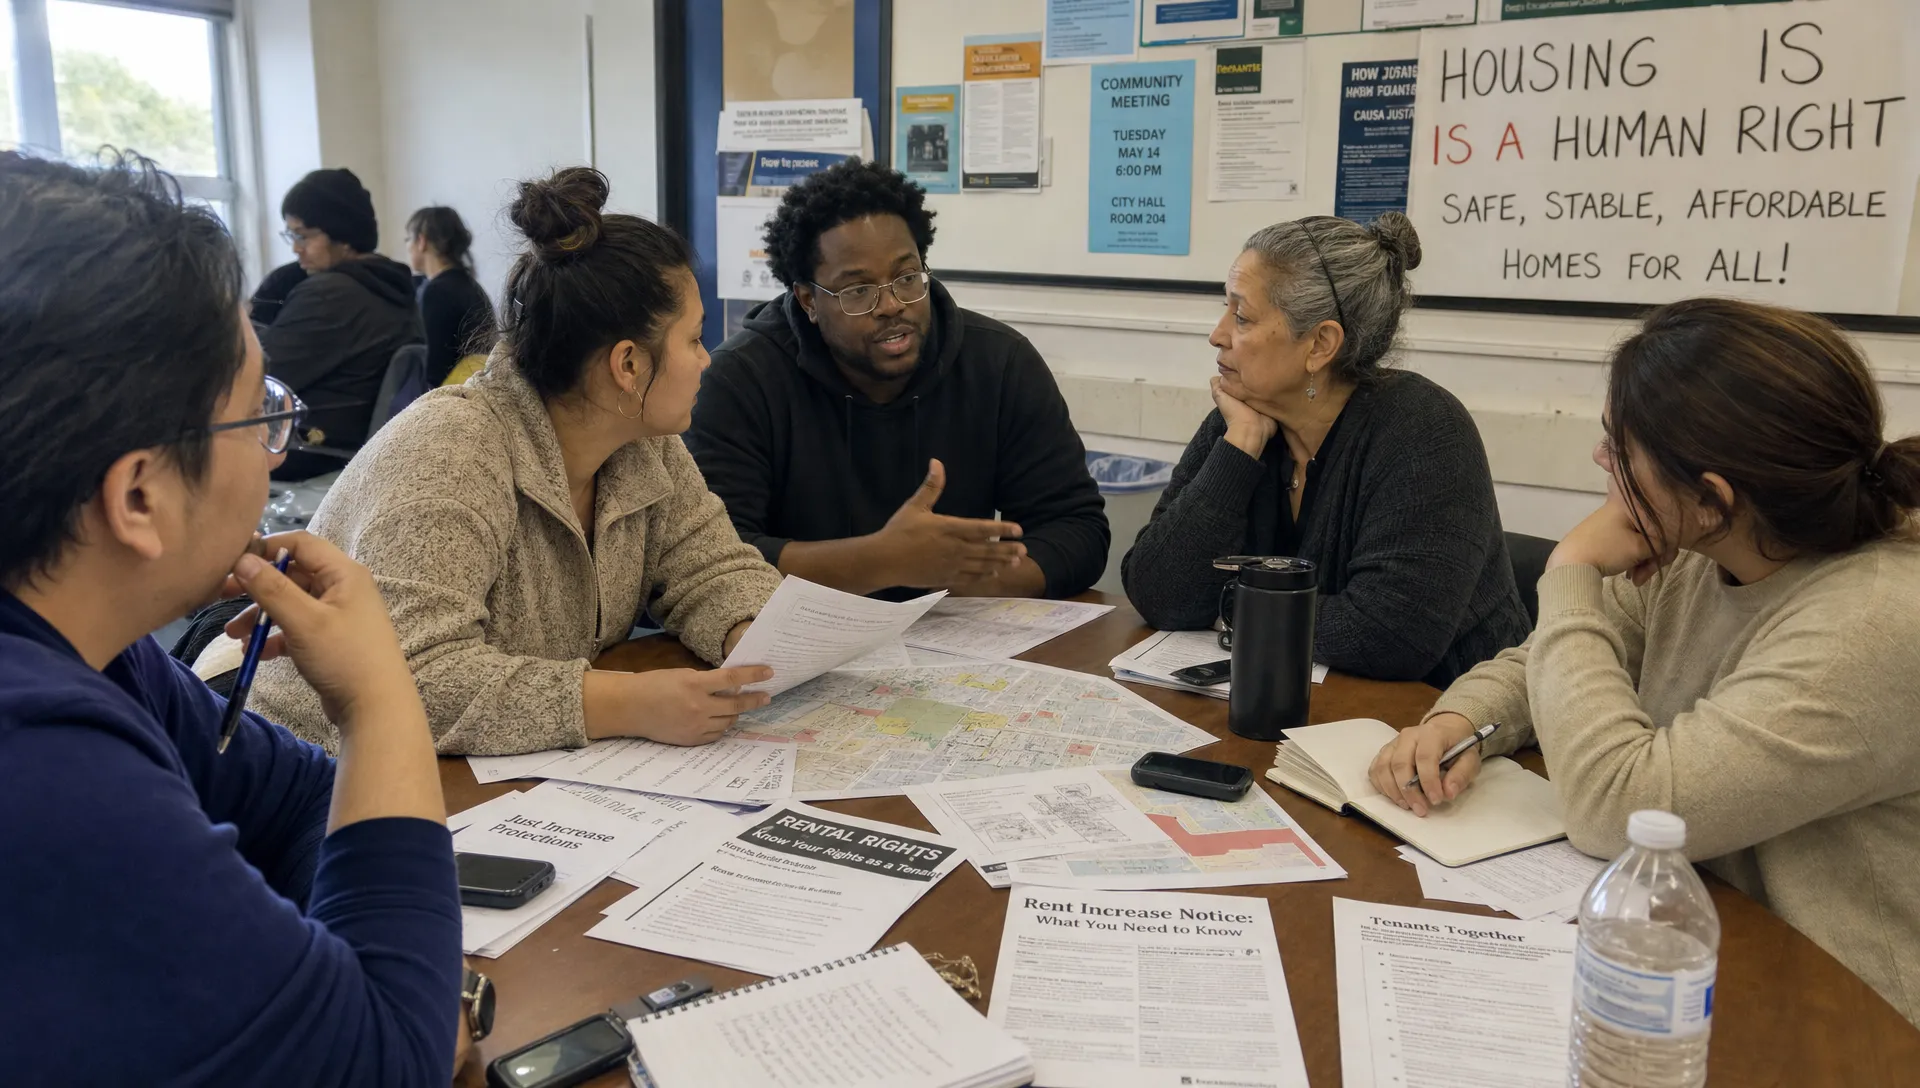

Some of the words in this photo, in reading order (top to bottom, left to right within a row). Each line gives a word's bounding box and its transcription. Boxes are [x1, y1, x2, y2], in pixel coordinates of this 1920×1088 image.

[1352, 67, 1379, 81] HOW
[1441, 36, 1657, 102] HOUSING
[1759, 22, 1824, 85] IS
[1101, 75, 1183, 90] COMMUNITY
[1111, 93, 1170, 108] MEETING
[1354, 110, 1384, 121] CAUSA
[1387, 108, 1415, 120] JUSTA
[1113, 129, 1166, 141] TUESDAY
[1432, 124, 1472, 165] IS
[1495, 122, 1524, 161] A
[1553, 107, 1706, 161] HUMAN
[1737, 96, 1906, 154] RIGHT
[1118, 147, 1144, 158] MAY
[1147, 147, 1160, 158] 14
[1116, 165, 1141, 176] 6:00
[1144, 165, 1162, 176] PM
[1111, 196, 1135, 207] CITY
[1138, 196, 1165, 207] HALL
[1442, 193, 1526, 226] SAFE,
[1545, 190, 1664, 226] STABLE,
[1687, 188, 1887, 220] AFFORDABLE
[1110, 213, 1143, 224] ROOM
[1146, 213, 1166, 224] 204
[1502, 248, 1601, 280] HOMES
[1628, 252, 1681, 280] FOR
[1705, 242, 1789, 284] ALL!
[488, 823, 583, 850] Protections
[504, 814, 544, 829] Just
[542, 820, 615, 843] Increase
[776, 815, 854, 842] RENTAL
[858, 834, 943, 862] RIGHTS
[752, 828, 791, 845] Know
[793, 838, 824, 853] Your
[822, 847, 865, 864] Rights
[865, 858, 881, 867] as
[883, 862, 894, 870] a
[1023, 897, 1074, 914] Rent
[1080, 902, 1173, 920] Increase
[1179, 908, 1254, 924] Notice:
[1036, 915, 1081, 928] What
[1085, 919, 1118, 932] You
[1123, 922, 1168, 934] Need
[1173, 925, 1191, 935] to
[1196, 925, 1243, 937] Know
[1369, 916, 1440, 932] Tenants
[1444, 924, 1526, 943] Together
